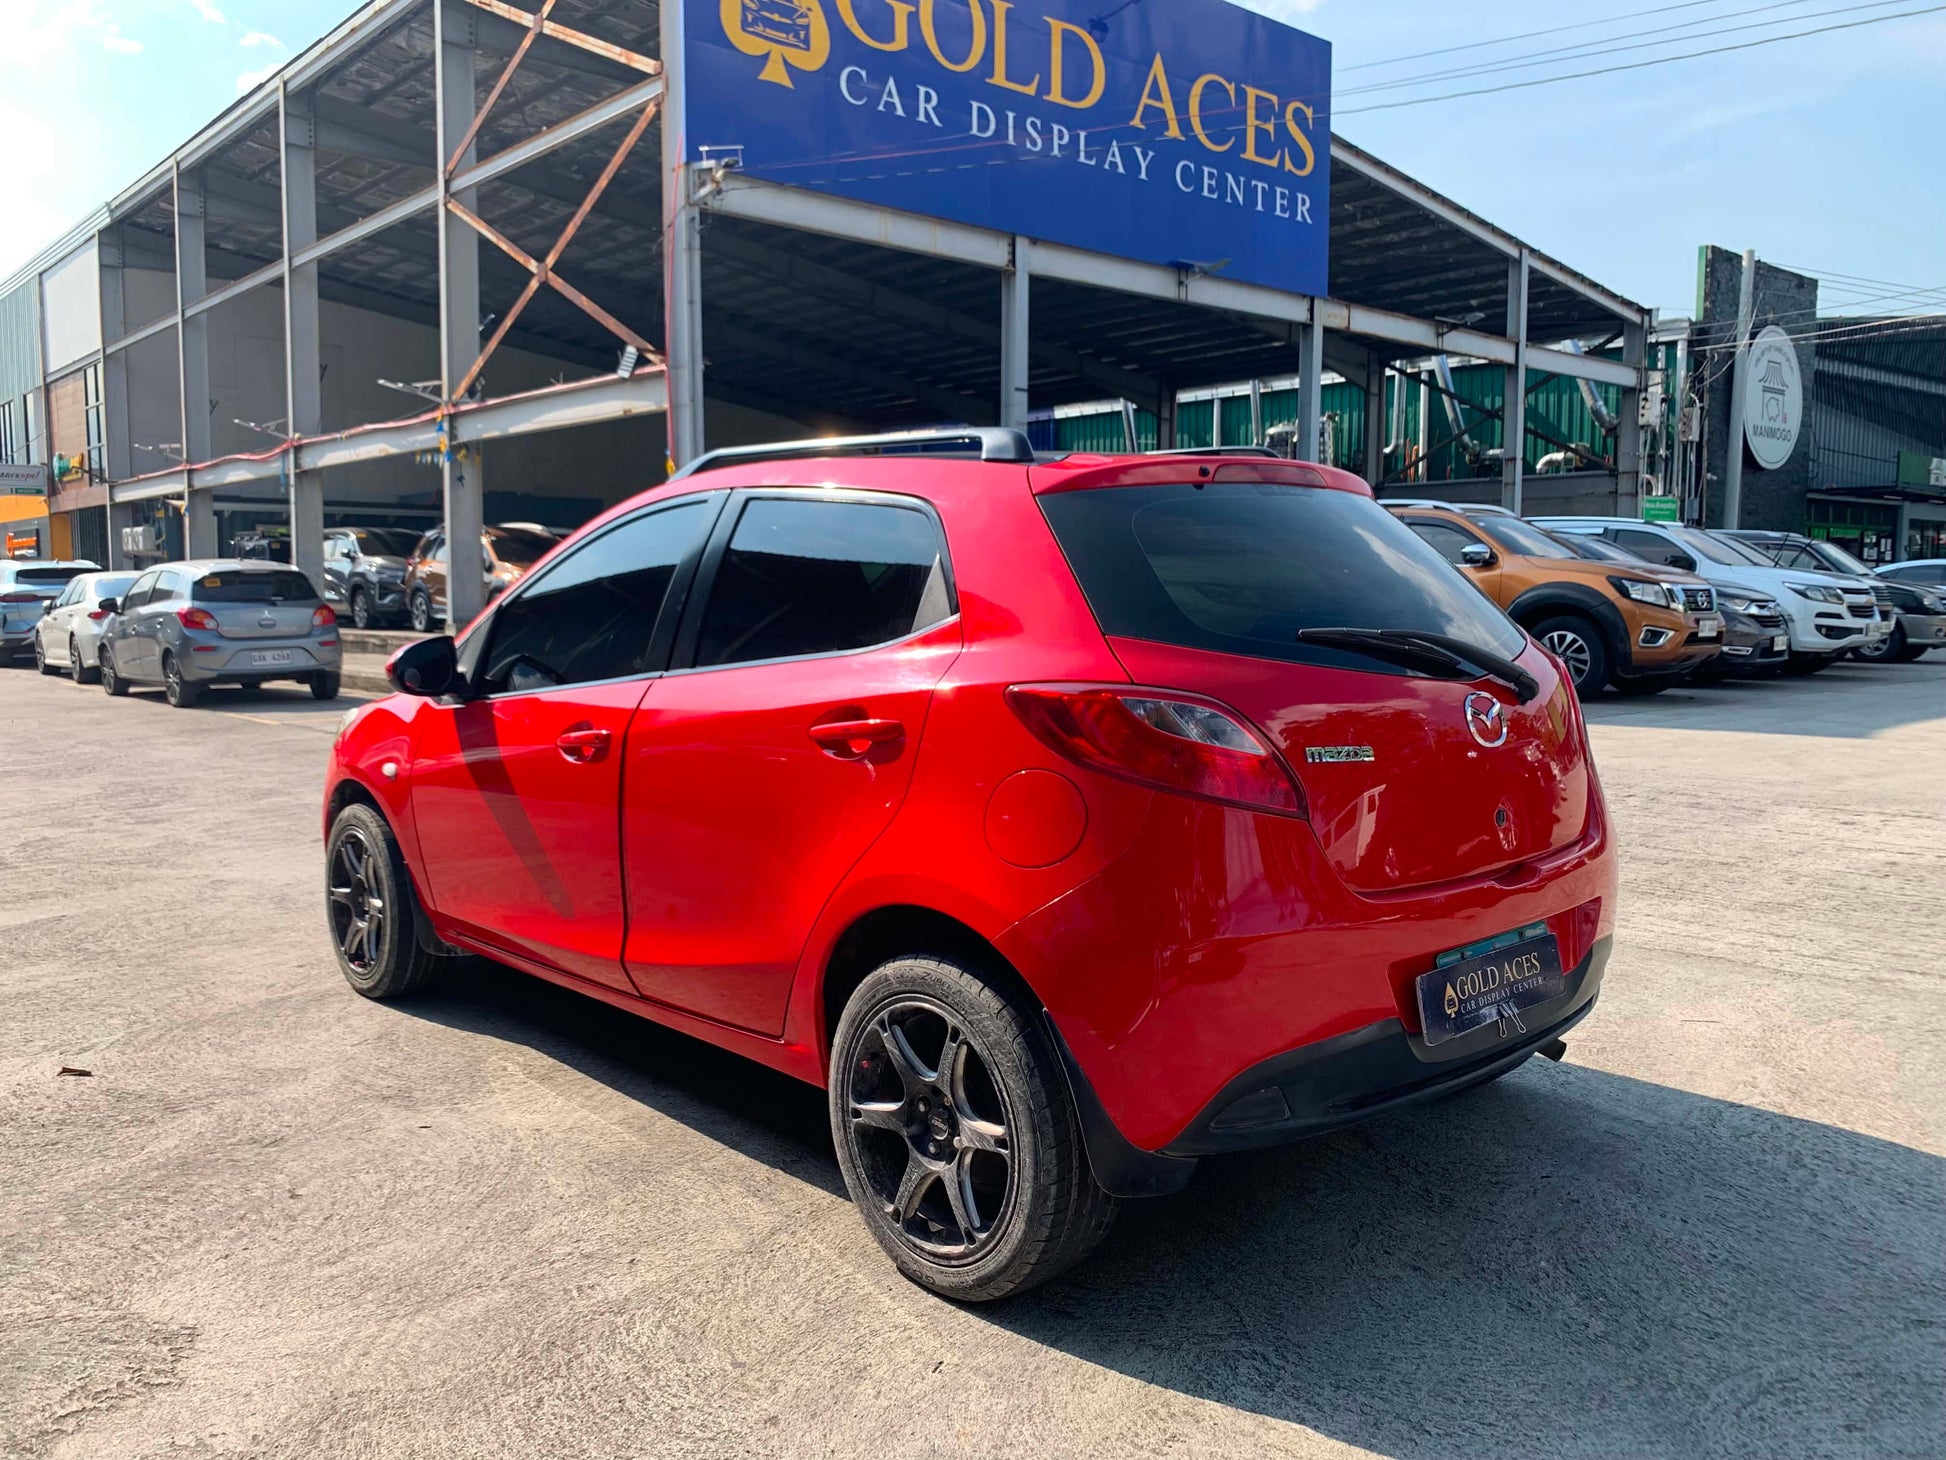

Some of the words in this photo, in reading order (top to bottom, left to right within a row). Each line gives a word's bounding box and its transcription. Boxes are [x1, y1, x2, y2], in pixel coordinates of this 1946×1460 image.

[1129, 52, 1315, 177] ACES
[839, 66, 943, 127] CAR
[969, 100, 1155, 181] DISPLAY
[1175, 160, 1313, 224] CENTER
[1752, 424, 1792, 442] MANIMOGO
[1456, 966, 1499, 999] GOLD
[1503, 952, 1540, 984] ACES
[1460, 1000, 1477, 1013] CAR
[1478, 986, 1511, 1007] DISPLAY
[1513, 976, 1544, 994] CENTER
